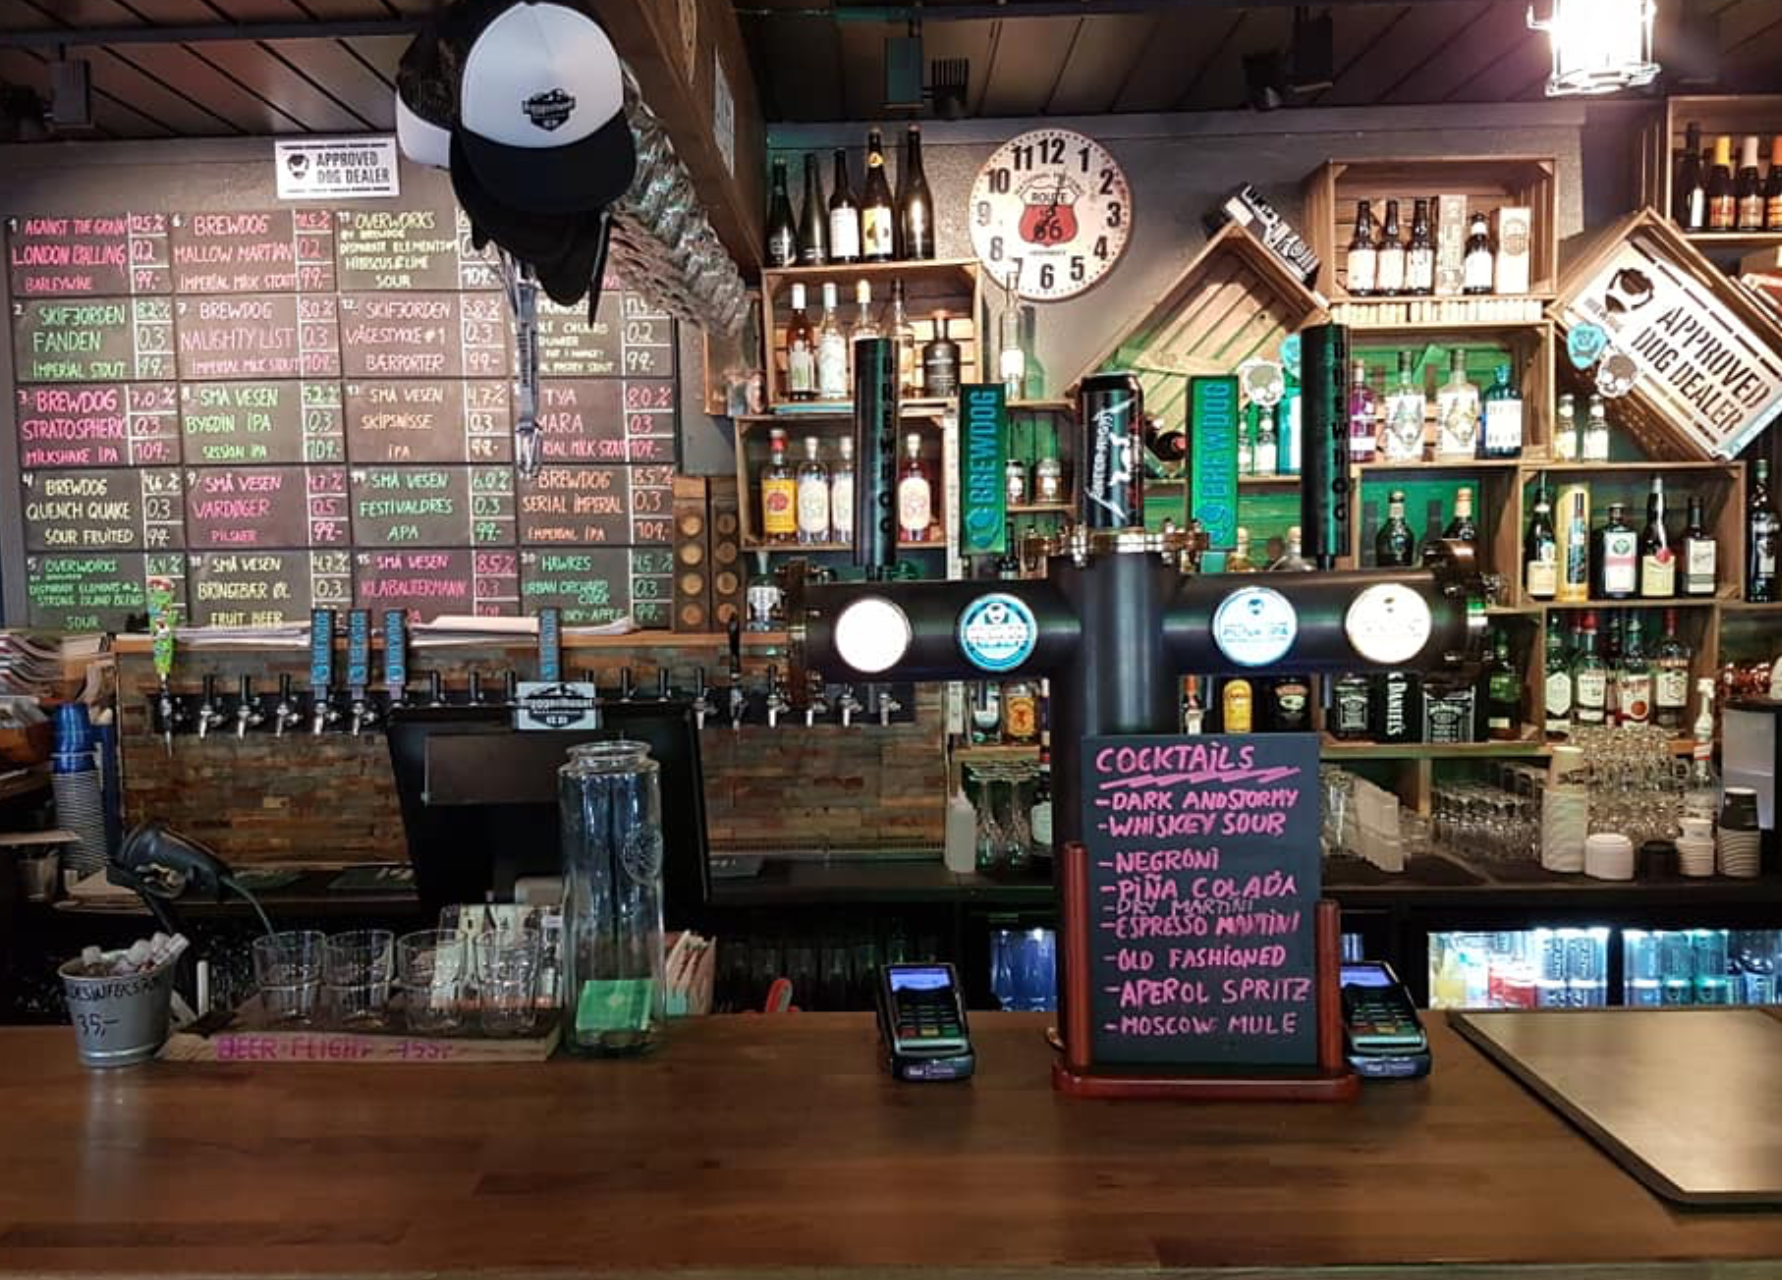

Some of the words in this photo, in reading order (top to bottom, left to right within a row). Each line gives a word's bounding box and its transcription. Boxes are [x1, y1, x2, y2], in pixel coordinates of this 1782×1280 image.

[315, 152, 379, 167] APPROVED
[1011, 145, 1033, 170] 11
[1037, 138, 1066, 164] 12
[1078, 147, 1090, 172] 1
[316, 169, 343, 184] DOG
[345, 168, 390, 185] DEALER
[987, 168, 1010, 194] 10
[1100, 169, 1114, 195] 2
[1031, 192, 1067, 202] ROUTE
[355, 212, 435, 229] OVERWORKS
[977, 201, 990, 227] 9
[1106, 202, 1121, 227] 3
[194, 215, 270, 235] BREWDOG
[1034, 220, 1062, 241] 66
[12, 244, 69, 265] LONDON
[174, 245, 232, 263] MALLOW
[990, 237, 1003, 262] 8
[1093, 236, 1108, 260] 4
[1012, 257, 1023, 290] 7
[1040, 264, 1054, 289] 6
[1070, 256, 1085, 281] 5
[376, 275, 411, 289] SOUR
[200, 303, 272, 319] BREWDOG
[366, 301, 450, 319] SKIFJORDEN
[33, 331, 101, 352] FANDEN
[181, 328, 256, 352] NAUGHTY
[258, 325, 295, 349] LIST
[1656, 306, 1771, 409] APPROVED
[1630, 326, 1679, 374] DOG
[1667, 361, 1745, 435] DEALER
[37, 389, 117, 413] BREWDOG
[235, 388, 279, 407] VESEN
[404, 387, 443, 403] VESEN
[247, 412, 271, 431] IPA
[970, 389, 998, 503] BREWDOG
[1201, 382, 1231, 498] BREWDOG
[25, 447, 90, 466] MILKSHAKE
[98, 446, 118, 462] IPA
[388, 444, 411, 459] IPA
[45, 479, 107, 496] BREWDOG
[238, 475, 282, 491] VESEN
[406, 472, 448, 488] VESEN
[538, 469, 613, 489] BREWDOG
[26, 502, 82, 521] QUENCH
[88, 502, 131, 520] QUAKE
[522, 494, 567, 513] SERIAL
[573, 492, 623, 513] IMPERIAL
[44, 528, 78, 545] SOUR
[84, 527, 133, 545] FRUITED
[388, 525, 419, 541] APA
[584, 525, 606, 541] IPA
[242, 557, 281, 572] VESEN
[407, 555, 449, 569] VESEN
[542, 555, 592, 571] HAWKES
[66, 615, 99, 630] SOUR
[211, 611, 244, 629] FRUIT
[1096, 741, 1254, 772] COCKTAILS
[1222, 812, 1286, 836] SOUR
[1172, 898, 1253, 917] MARTINI
[1169, 944, 1286, 969] FASHIONED
[1222, 978, 1311, 1003] SPRITZ
[1228, 1012, 1298, 1035] MULE
